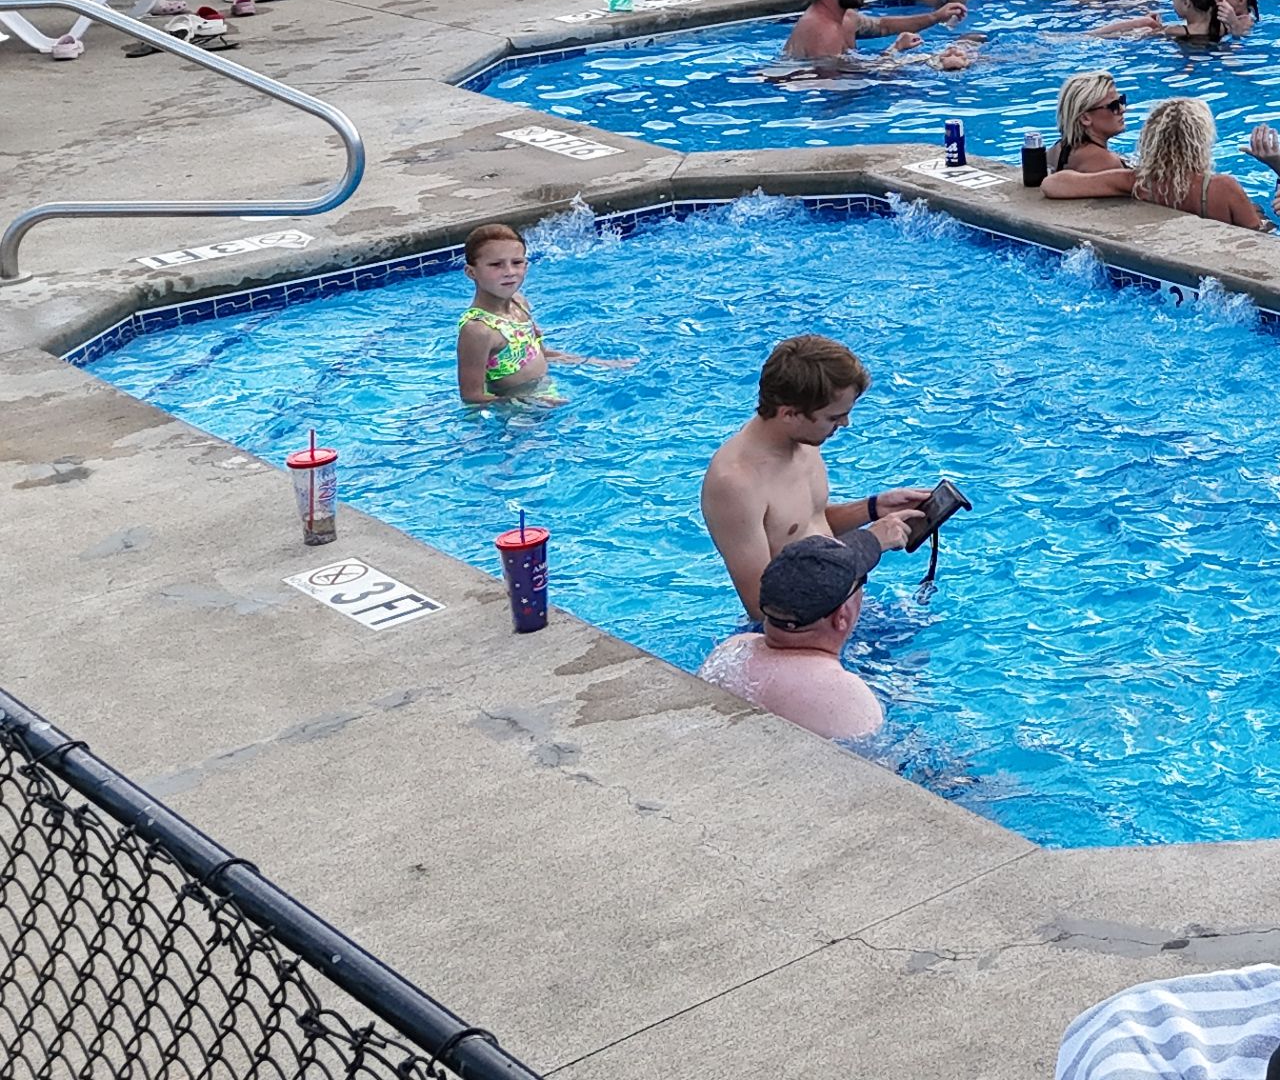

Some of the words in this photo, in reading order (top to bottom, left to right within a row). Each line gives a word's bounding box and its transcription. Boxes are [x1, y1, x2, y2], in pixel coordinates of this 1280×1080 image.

[955, 174, 1002, 188] FT
[208, 242, 245, 254] 3
[149, 249, 203, 267] FT
[330, 581, 396, 605] 3
[351, 593, 441, 626] FT
